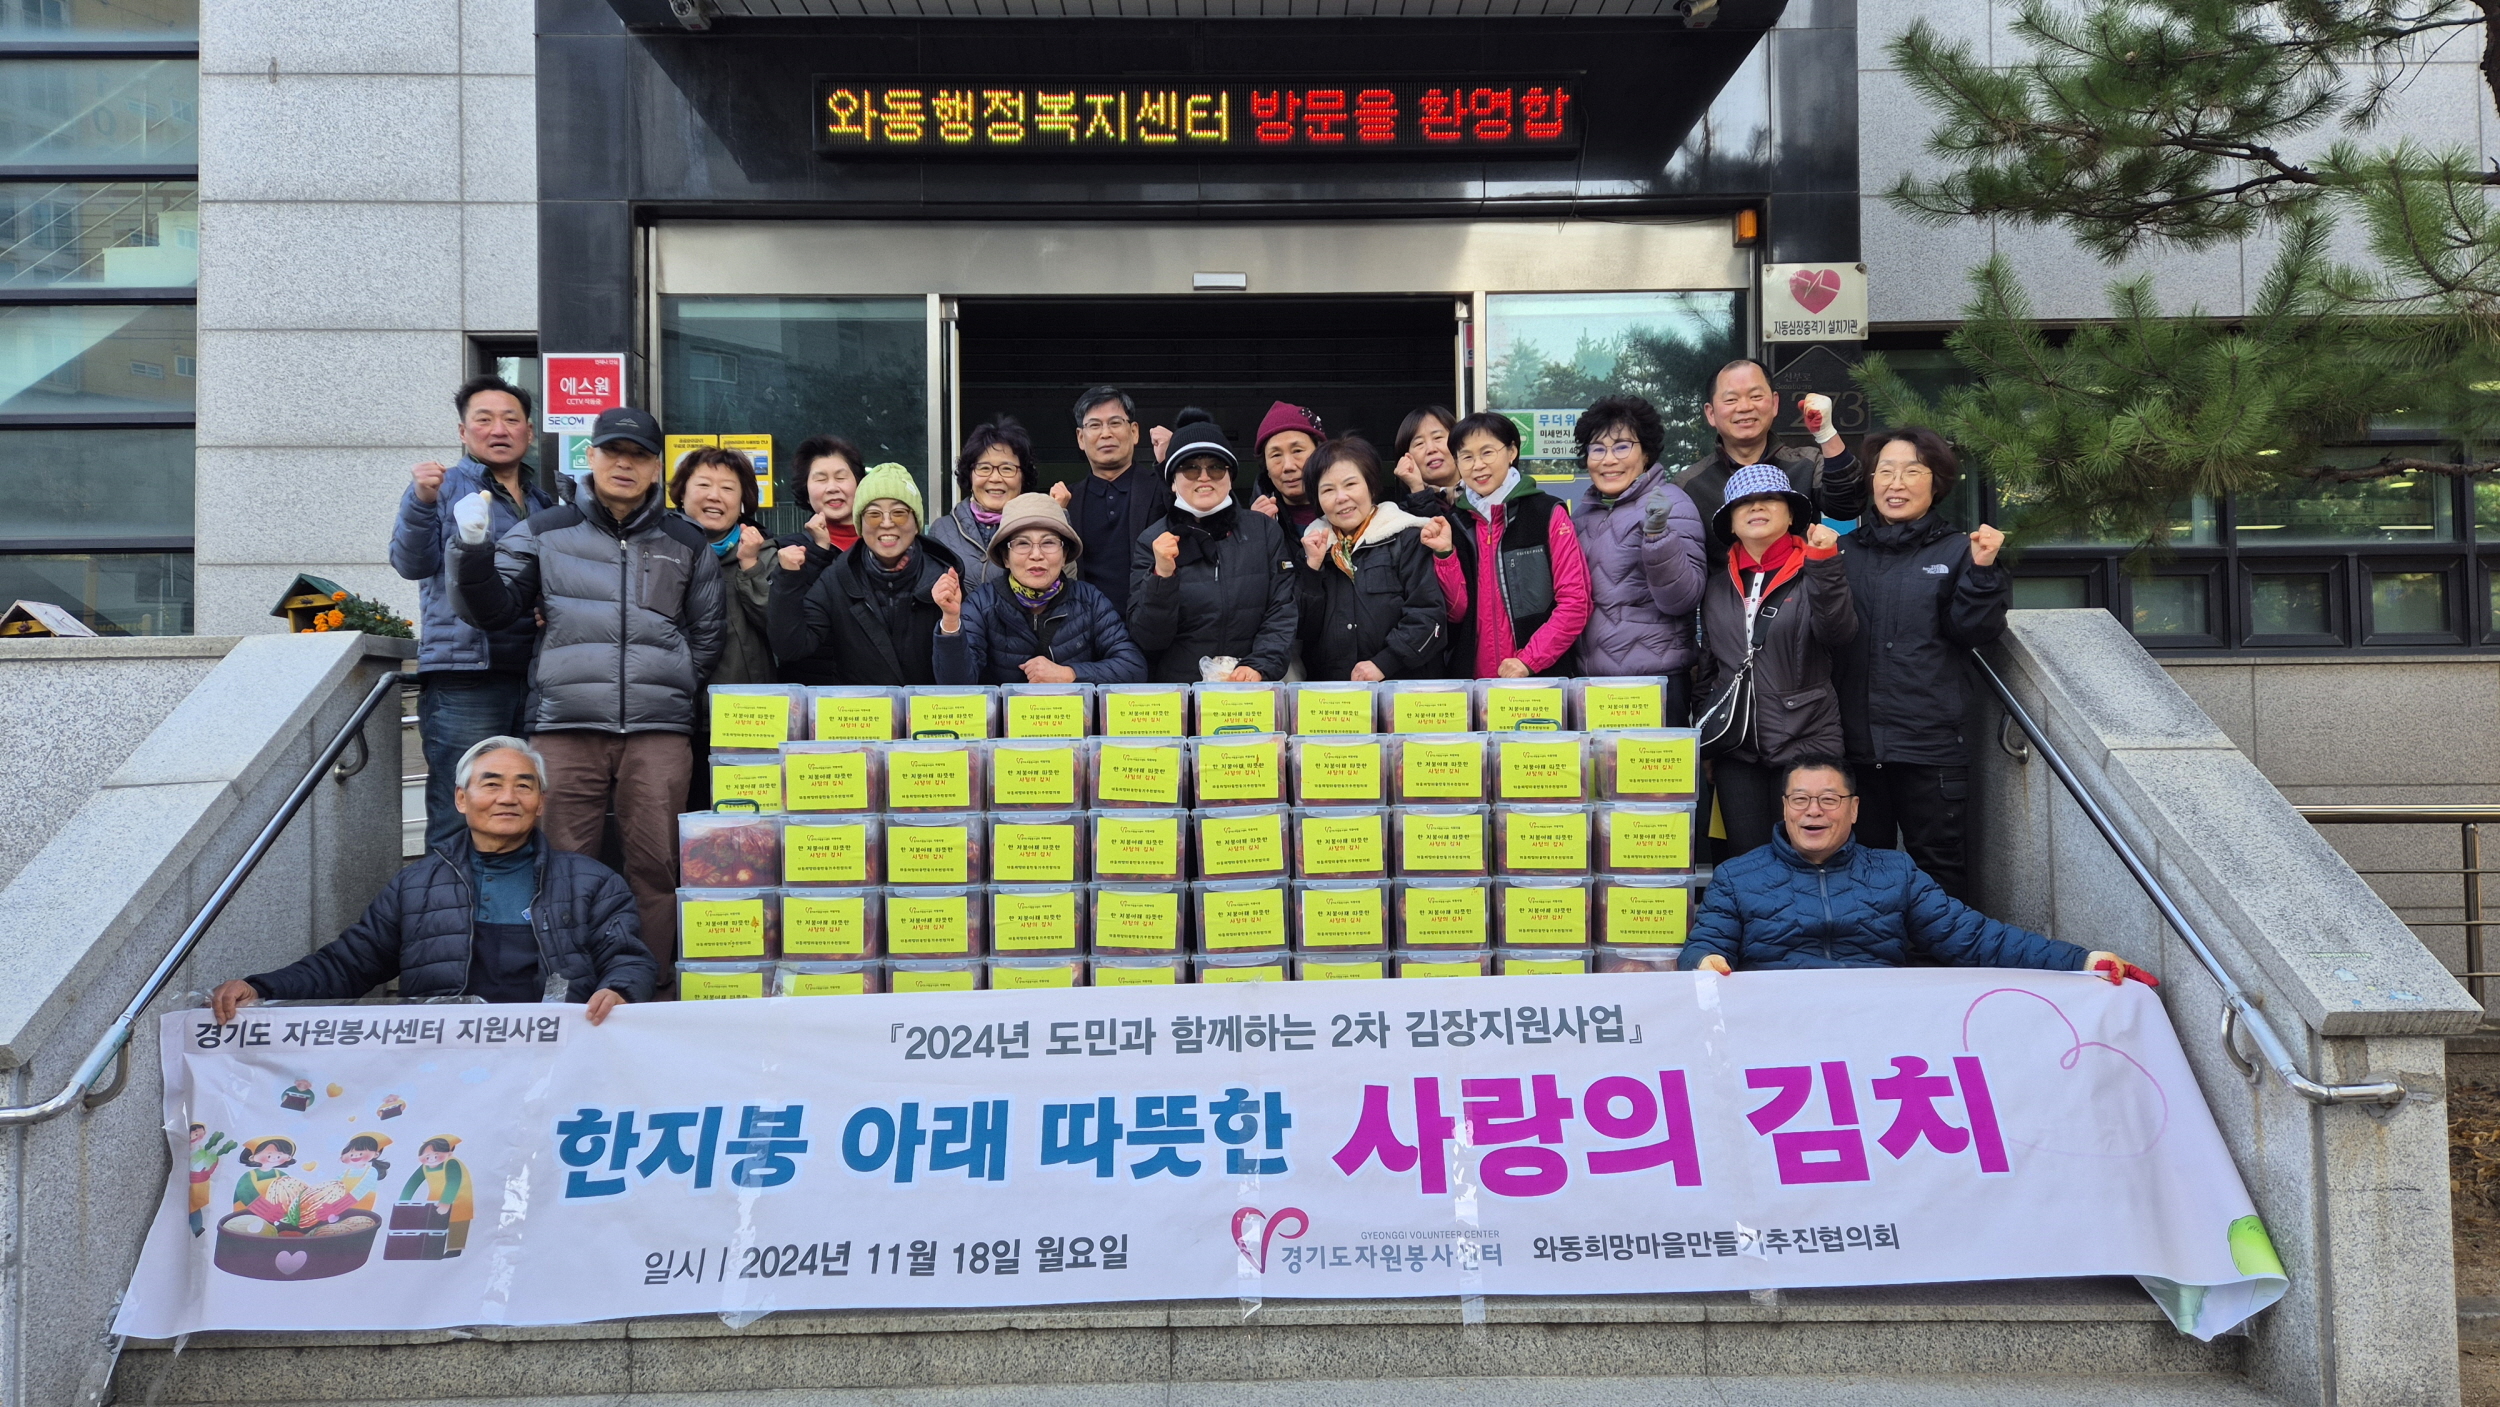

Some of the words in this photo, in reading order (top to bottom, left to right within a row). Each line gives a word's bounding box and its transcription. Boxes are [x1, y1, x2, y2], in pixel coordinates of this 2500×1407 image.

[828, 88, 1227, 142] 와동행정복지센터
[1251, 89, 1399, 140] 방문을
[1419, 87, 1571, 139] 환영합
[1773, 320, 1826, 336] 자동심장충격기
[1827, 319, 1858, 335] 설치기관
[560, 377, 609, 396] 에스원
[548, 416, 585, 426] SECOM
[1538, 413, 1576, 427] 무더위
[1540, 429, 1571, 438] 미세먼지
[194, 1020, 270, 1048] 경기도
[282, 1019, 444, 1046] 자원봉사센터
[457, 1017, 560, 1043] 지원사업
[1046, 1018, 1156, 1056] 도민과
[1171, 1014, 1316, 1054] 함께하는
[1332, 1011, 1390, 1048] 2차
[557, 1105, 808, 1198] 한지붕
[842, 1100, 1008, 1183] 아래
[1041, 1088, 1291, 1179] 따뜻한
[1332, 1070, 1702, 1197] 사랑의
[1745, 1056, 2009, 1185] 김치
[1360, 1230, 1408, 1240] GYEONGGI
[1409, 1230, 1462, 1240] VOLUNTEER
[1464, 1230, 1500, 1239] CENTER
[644, 1248, 705, 1284] 일시
[739, 1241, 851, 1278] 2024년
[868, 1240, 937, 1276] 11월
[953, 1239, 1020, 1275] 18일
[1035, 1234, 1127, 1272] 월요일
